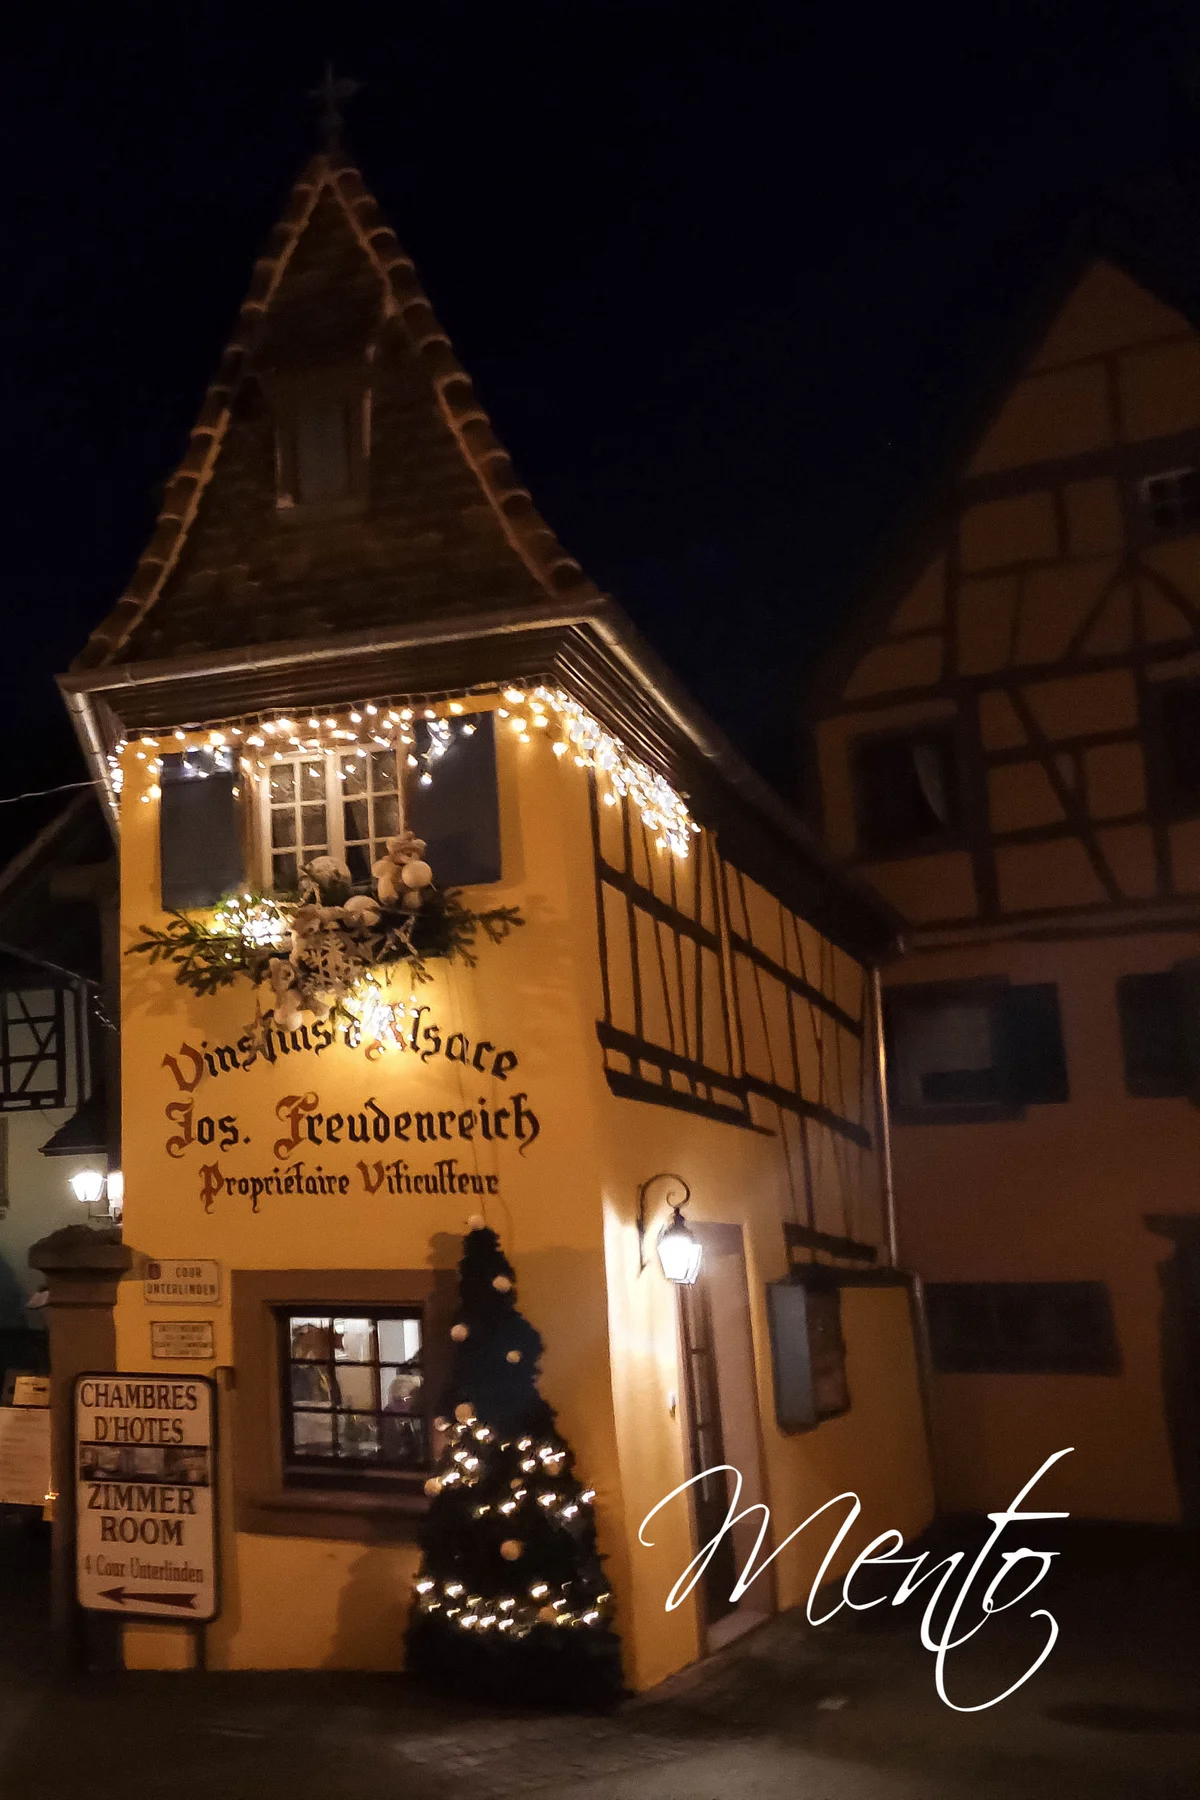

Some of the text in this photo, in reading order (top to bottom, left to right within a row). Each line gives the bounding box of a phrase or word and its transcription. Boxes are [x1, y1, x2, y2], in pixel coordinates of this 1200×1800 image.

[161, 1035, 258, 1093] Vins
[330, 1004, 519, 1082] dAlsace
[165, 1091, 541, 1160] Jos. Freudenreich
[200, 1158, 499, 1214] Propriétaire Viticulteur
[176, 1267, 202, 1278] COUR
[147, 1283, 216, 1295] UNTERLINDEN
[80, 1382, 198, 1411] CHAMBRES
[94, 1415, 184, 1443] D'HOTES
[87, 1482, 197, 1515] ZIMMER
[100, 1515, 184, 1546] ROOM
[130, 1557, 204, 1583] Unterlinden
